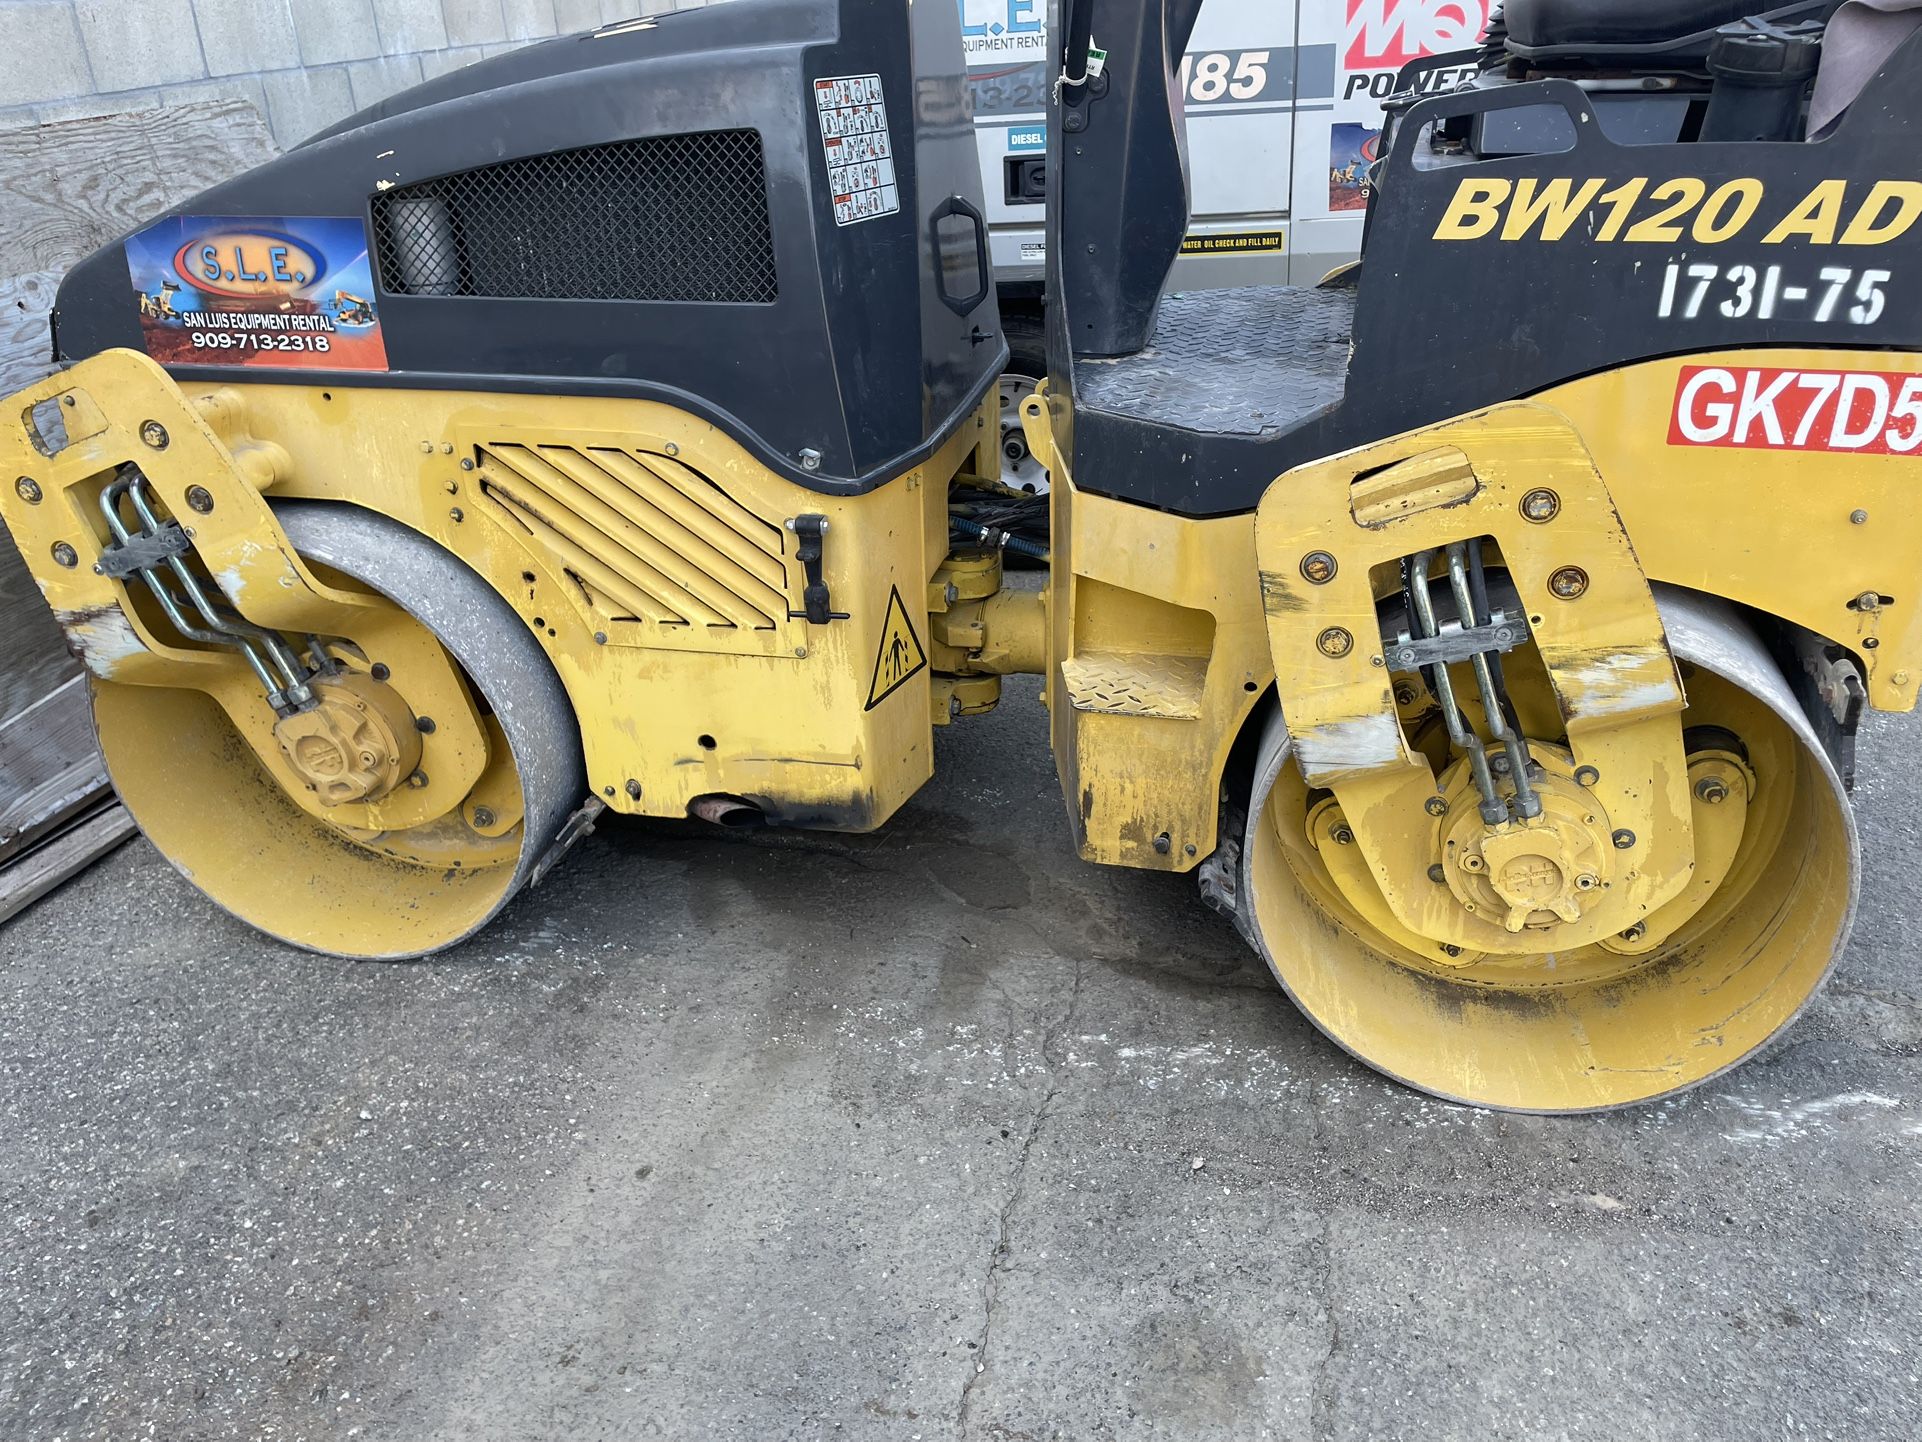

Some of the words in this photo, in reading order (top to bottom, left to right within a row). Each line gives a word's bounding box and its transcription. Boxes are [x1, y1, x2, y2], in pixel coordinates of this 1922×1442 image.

[1017, 35, 1047, 48] RENT
[1181, 52, 1269, 101] 185
[1011, 133, 1043, 145] DIESEL
[1432, 177, 1764, 244] BW120
[1760, 179, 1922, 245] AD
[1204, 240, 1215, 248] OIL
[1215, 239, 1234, 248] CHECK
[1235, 238, 1247, 247] AND
[1248, 238, 1261, 246] FILL
[1262, 237, 1279, 246] DAILY
[201, 246, 306, 283] S.L.E.
[1657, 264, 1891, 325] 1731-75
[182, 311, 207, 328] SAN
[207, 312, 230, 329] LUIS
[230, 313, 290, 331] EQUIPMENT
[290, 314, 335, 332] RENTAL
[191, 331, 331, 352] 909-713-2318
[1676, 368, 1922, 452] GK7D5
